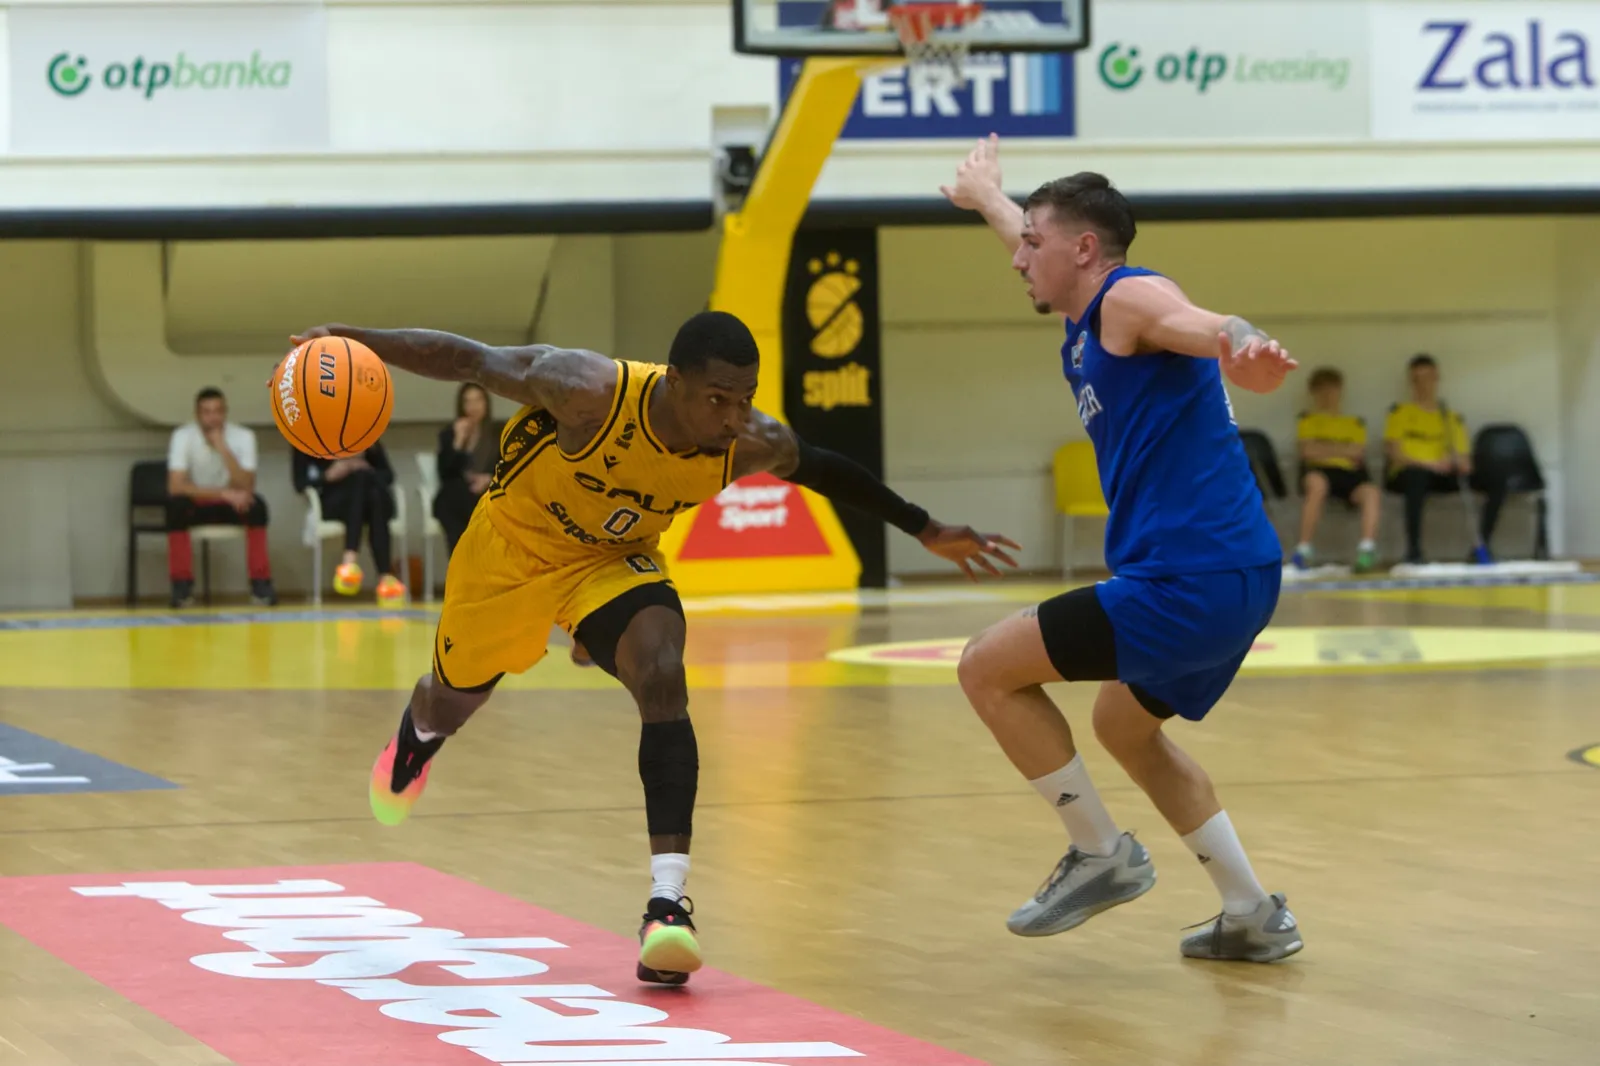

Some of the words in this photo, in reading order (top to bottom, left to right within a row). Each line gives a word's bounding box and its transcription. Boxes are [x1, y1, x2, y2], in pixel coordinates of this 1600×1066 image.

[102, 50, 292, 100] otpbanka
[1156, 47, 1228, 93] otp
[1234, 50, 1352, 91] Leasing
[1416, 19, 1596, 91] Zala
[319, 352, 336, 398] EVO
[803, 362, 873, 411] split
[601, 506, 642, 538] 0
[718, 504, 789, 532] Sport
